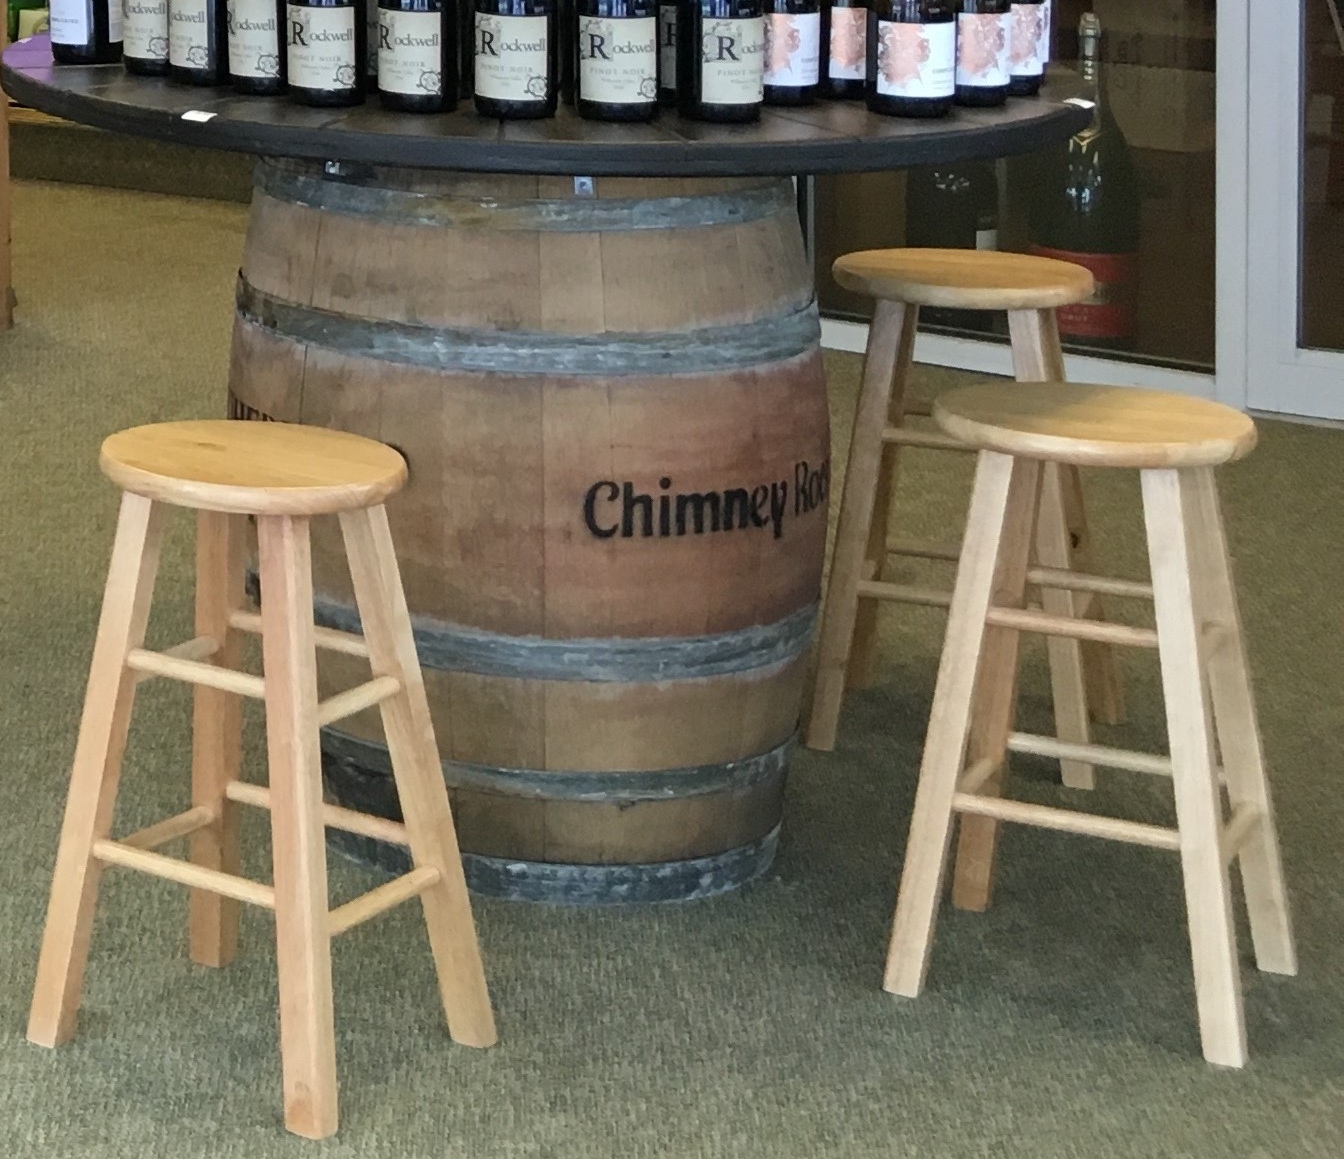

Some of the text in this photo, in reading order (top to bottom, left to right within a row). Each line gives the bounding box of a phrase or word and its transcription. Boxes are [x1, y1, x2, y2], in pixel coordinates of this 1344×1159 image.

[292, 21, 354, 46] Rockwell
[379, 24, 439, 50] Rockwell
[480, 30, 547, 56] Rockwell
[583, 477, 787, 539] Chimney
